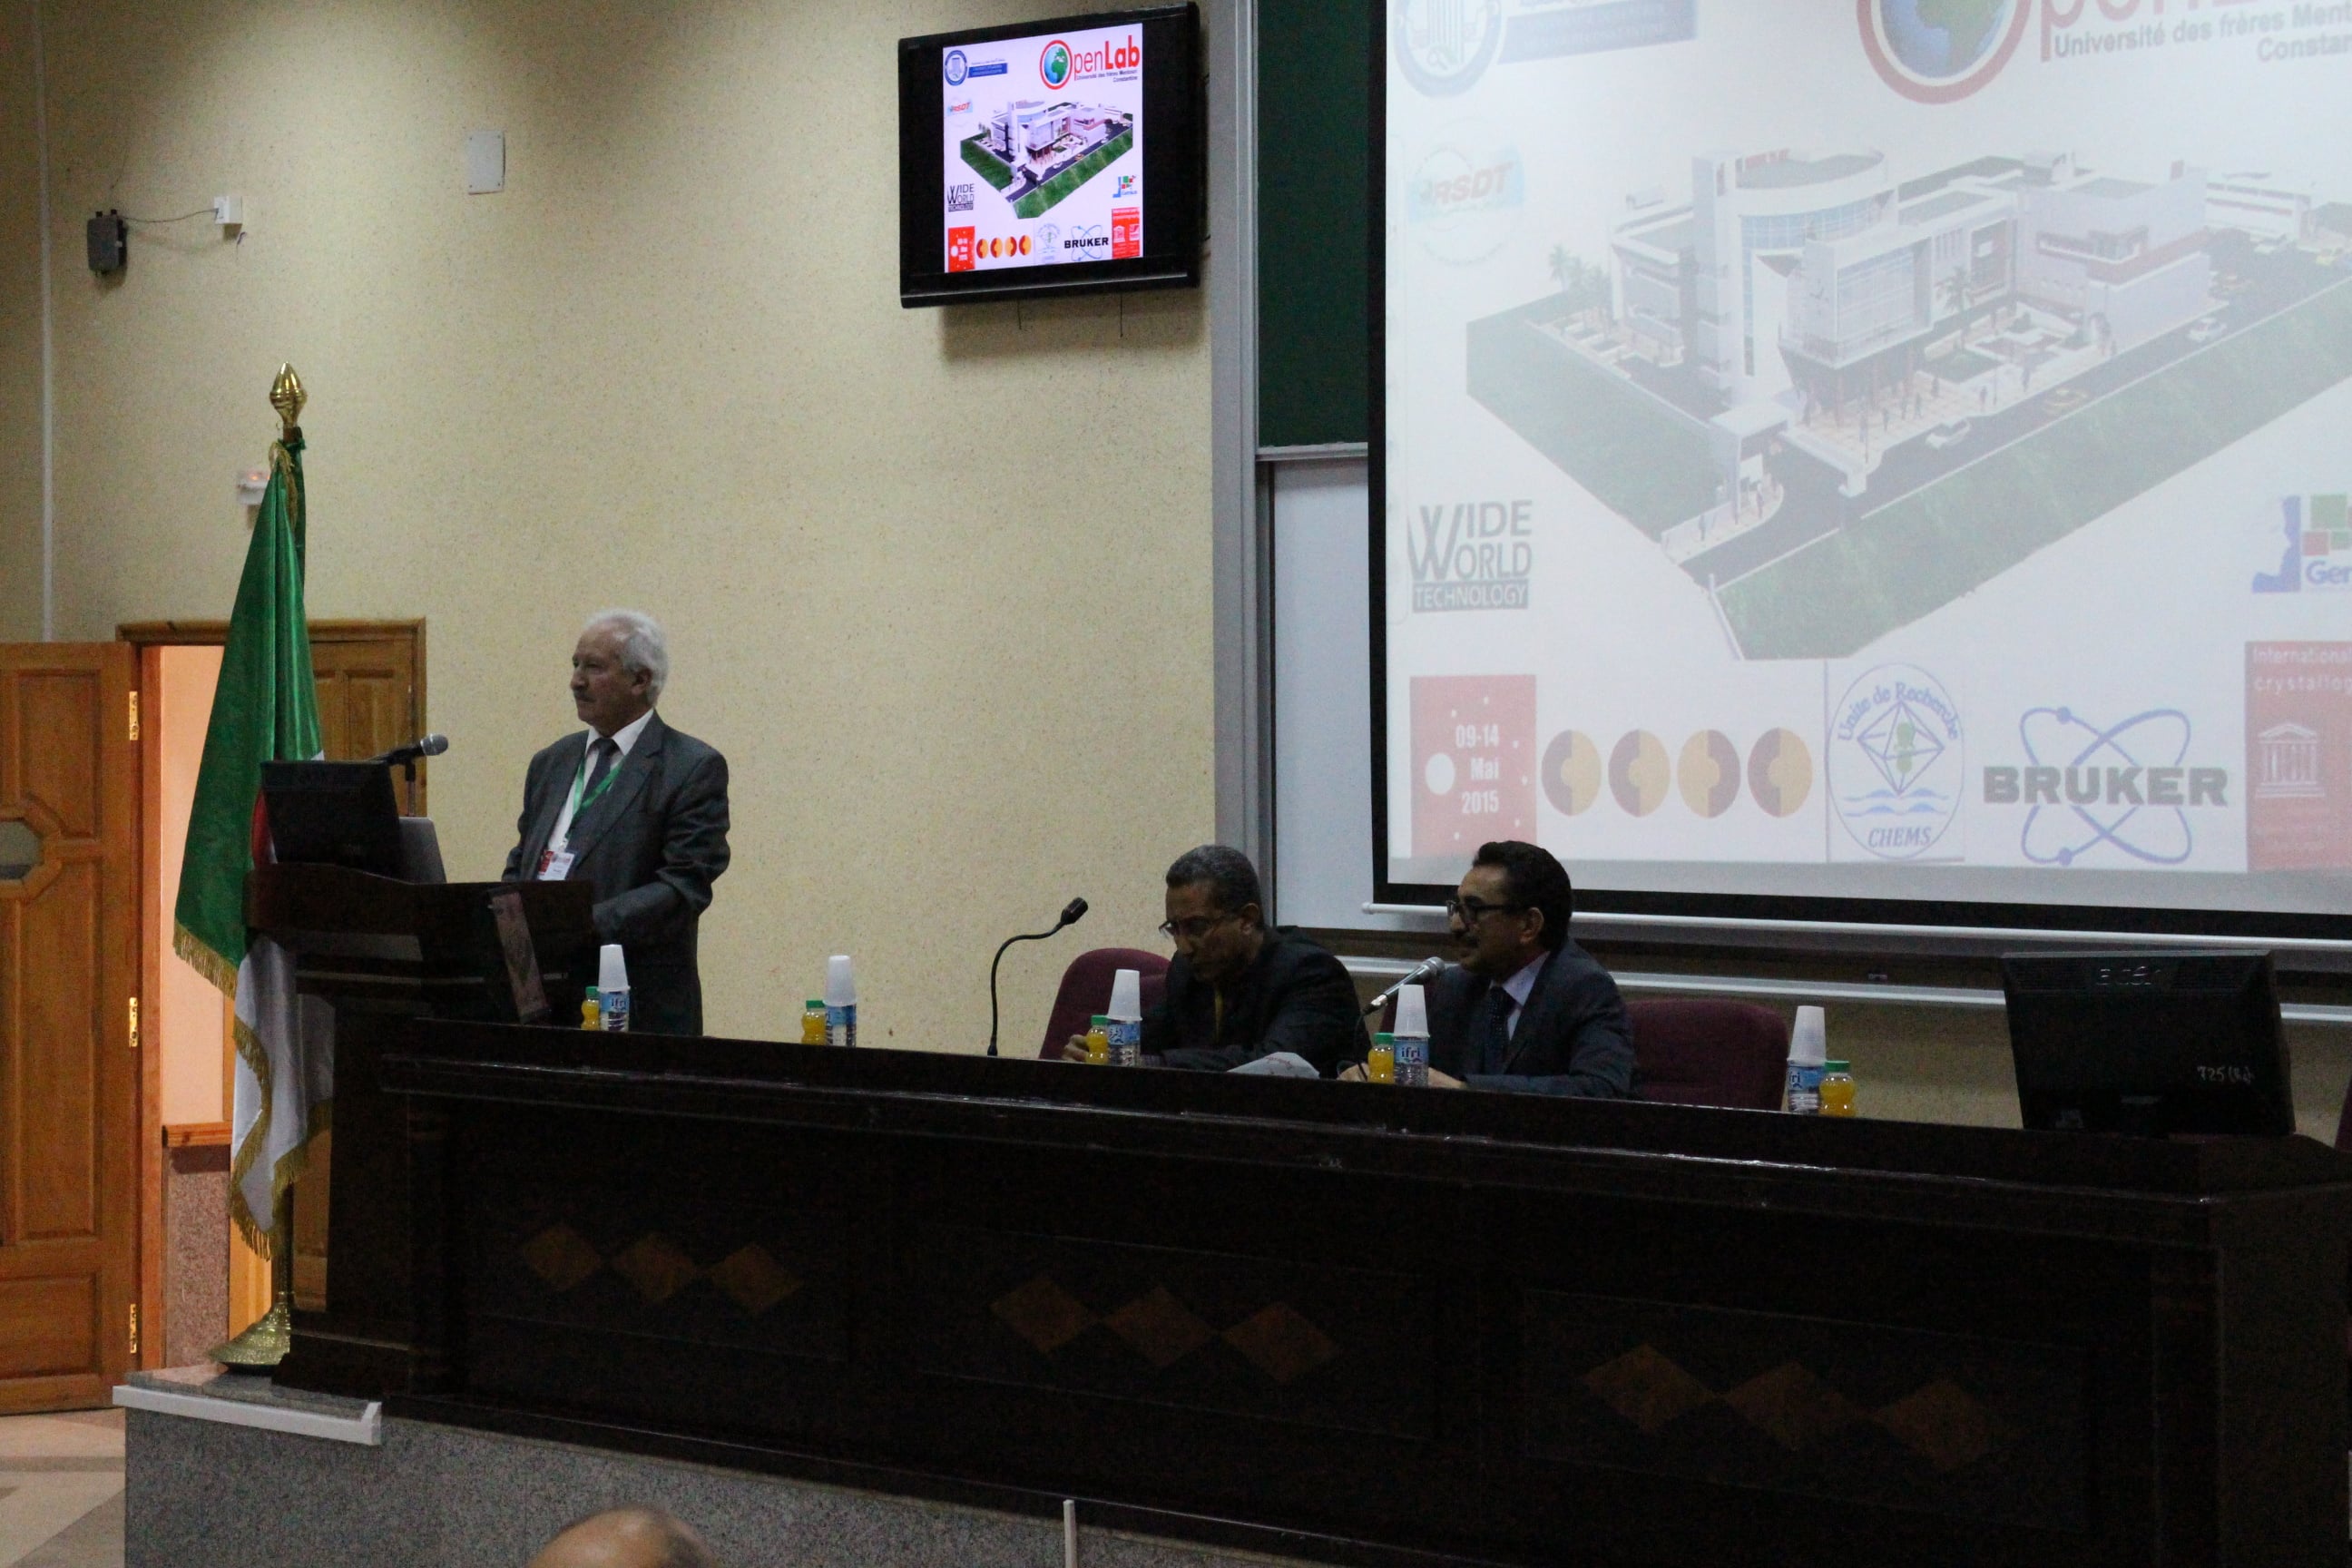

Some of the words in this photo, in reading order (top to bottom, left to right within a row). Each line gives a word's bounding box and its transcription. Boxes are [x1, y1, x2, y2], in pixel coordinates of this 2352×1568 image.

[2054, 23, 2166, 58] Université
[2172, 19, 2213, 44] des
[2220, 10, 2285, 37] frères
[947, 183, 975, 197] WIDE
[948, 191, 975, 203] WORLD
[1064, 237, 1109, 249] BRUKER
[1407, 499, 1534, 557] WIDE
[1408, 523, 1533, 581] WORLD
[1413, 583, 1528, 609] TECHNOLOGY
[1872, 684, 1891, 705] de
[1471, 757, 1500, 780] Mai
[1983, 765, 2229, 807] BRUKER
[1462, 790, 1500, 815] 2015
[1867, 825, 1932, 848] CHEMS
[1401, 1047, 1421, 1058] ifri
